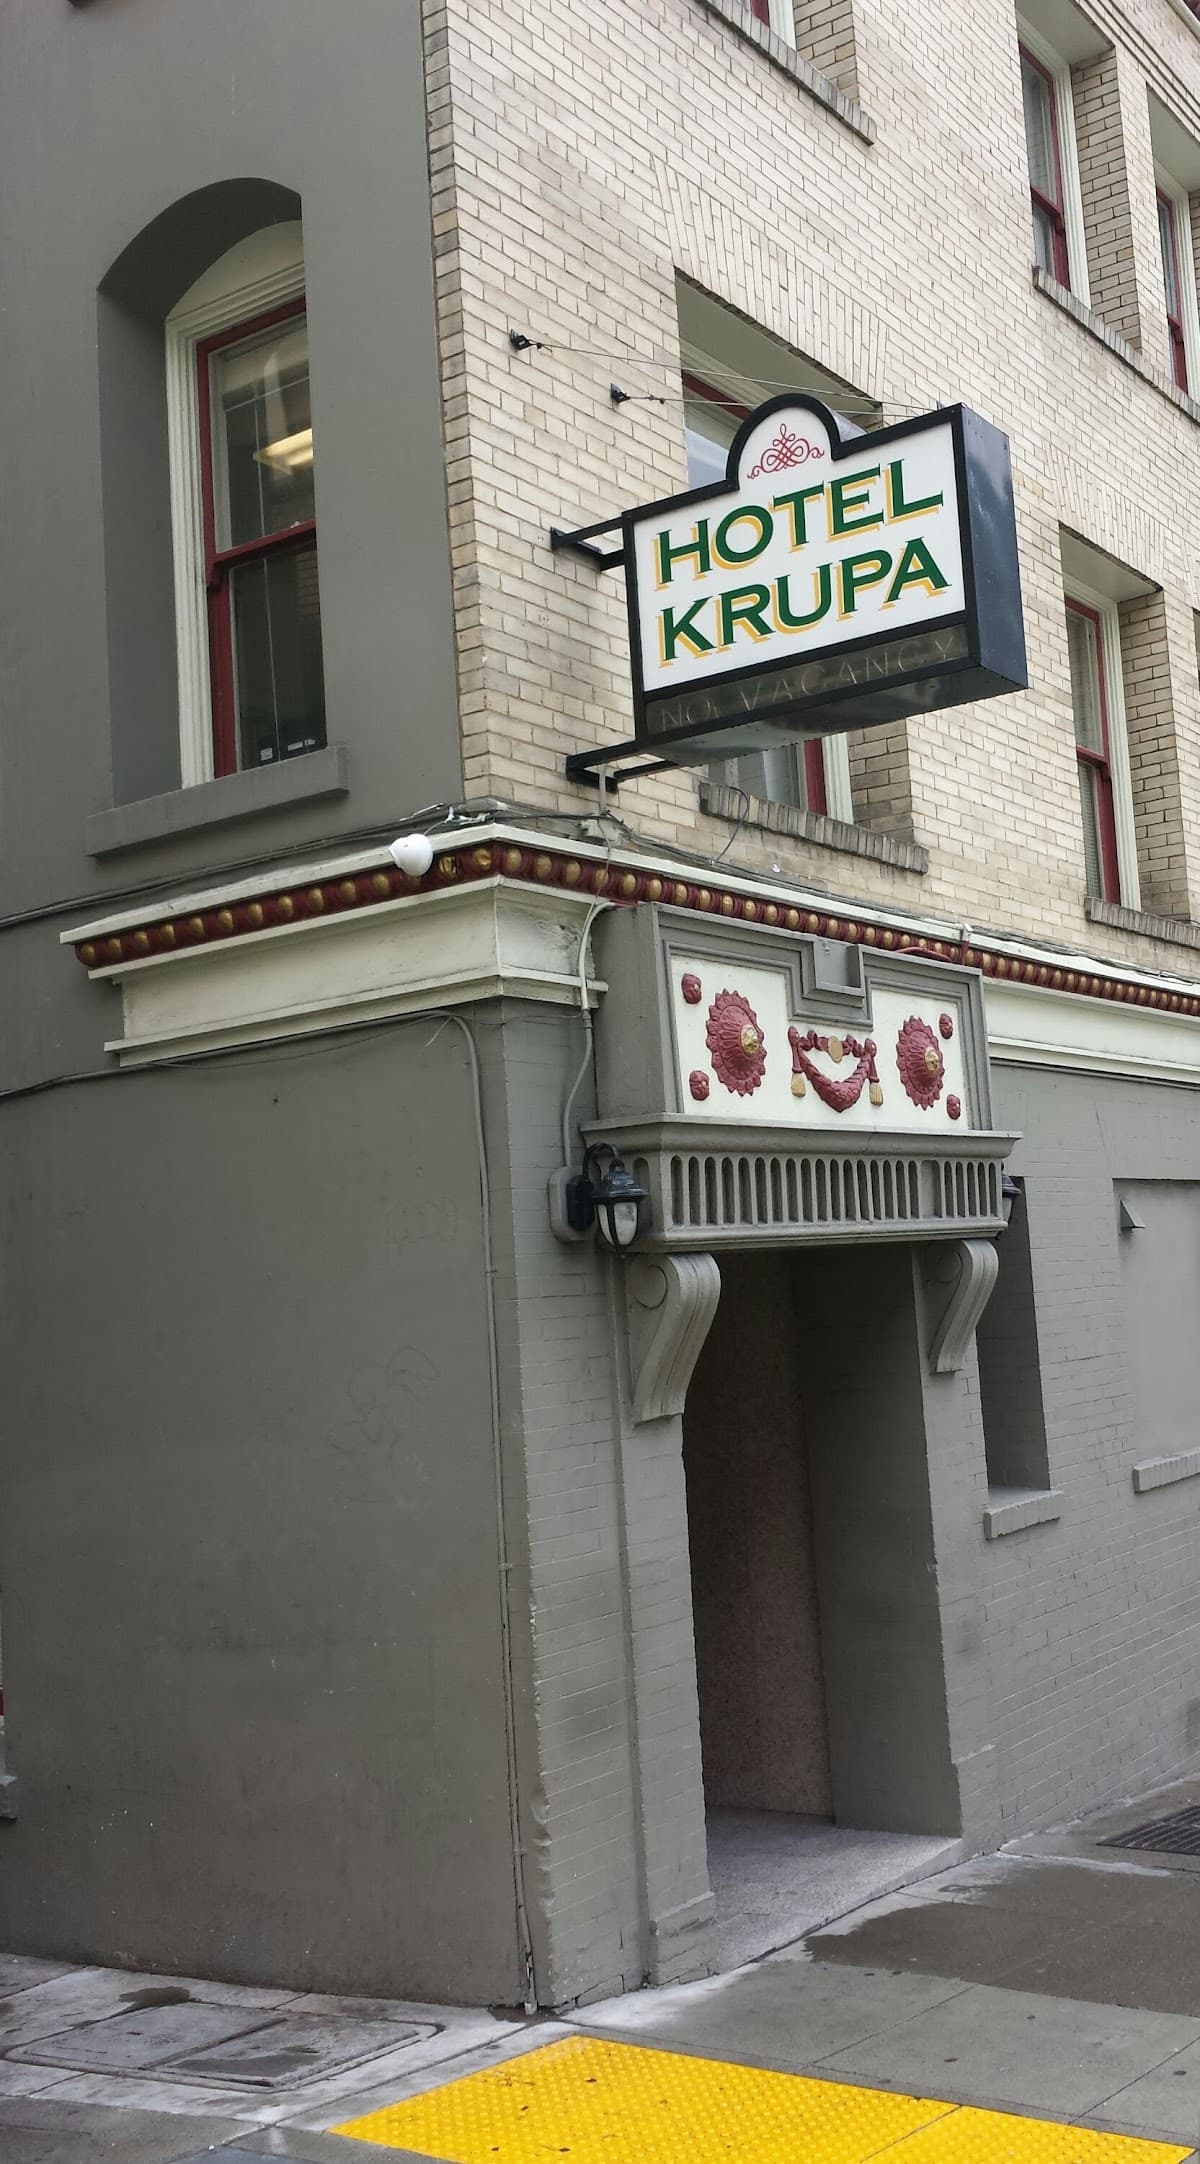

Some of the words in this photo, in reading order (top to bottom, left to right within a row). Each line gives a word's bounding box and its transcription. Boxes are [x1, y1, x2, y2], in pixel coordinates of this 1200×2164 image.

[654, 458, 944, 591] HOTEL
[656, 536, 952, 668] KRUPA
[659, 700, 716, 732] NO
[736, 634, 956, 711] VACANCY
